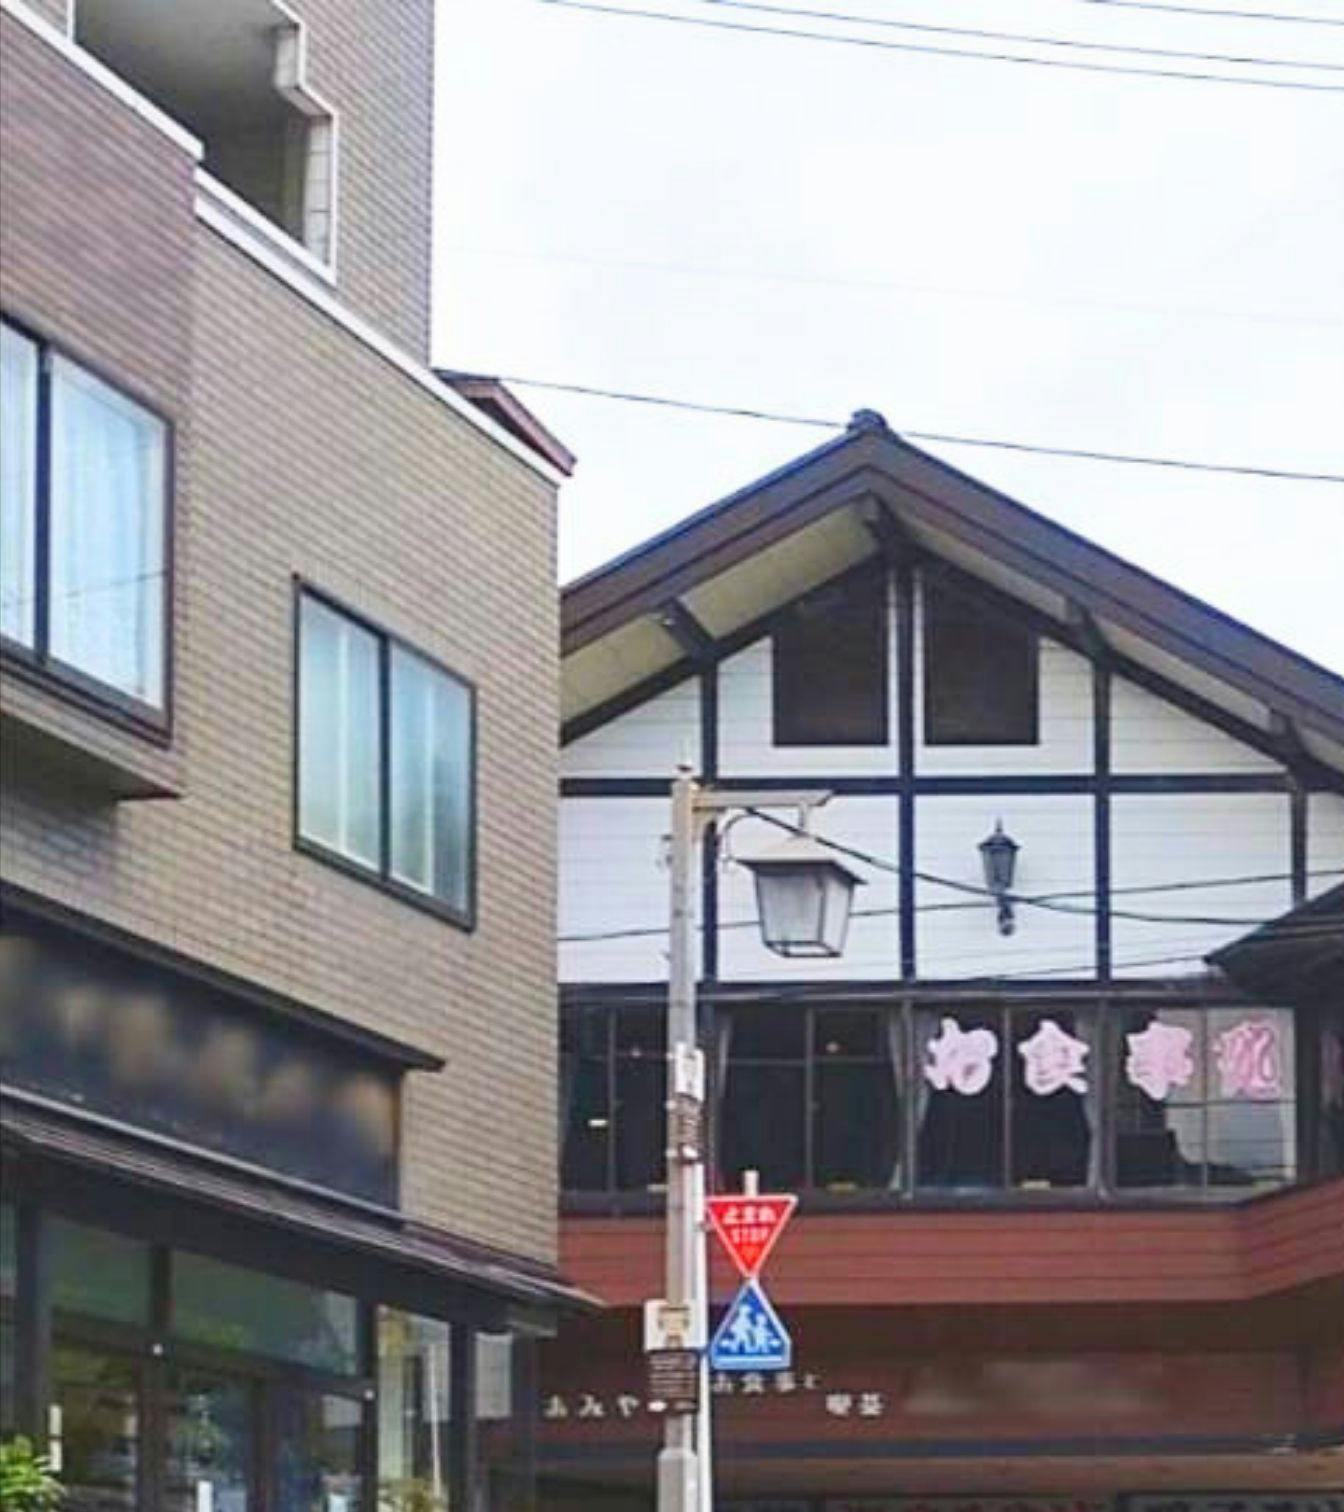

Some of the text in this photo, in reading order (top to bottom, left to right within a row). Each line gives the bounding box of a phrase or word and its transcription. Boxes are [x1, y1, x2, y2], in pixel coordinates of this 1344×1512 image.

[723, 1206, 777, 1224] 止まれ
[731, 1228, 769, 1243] STOP
